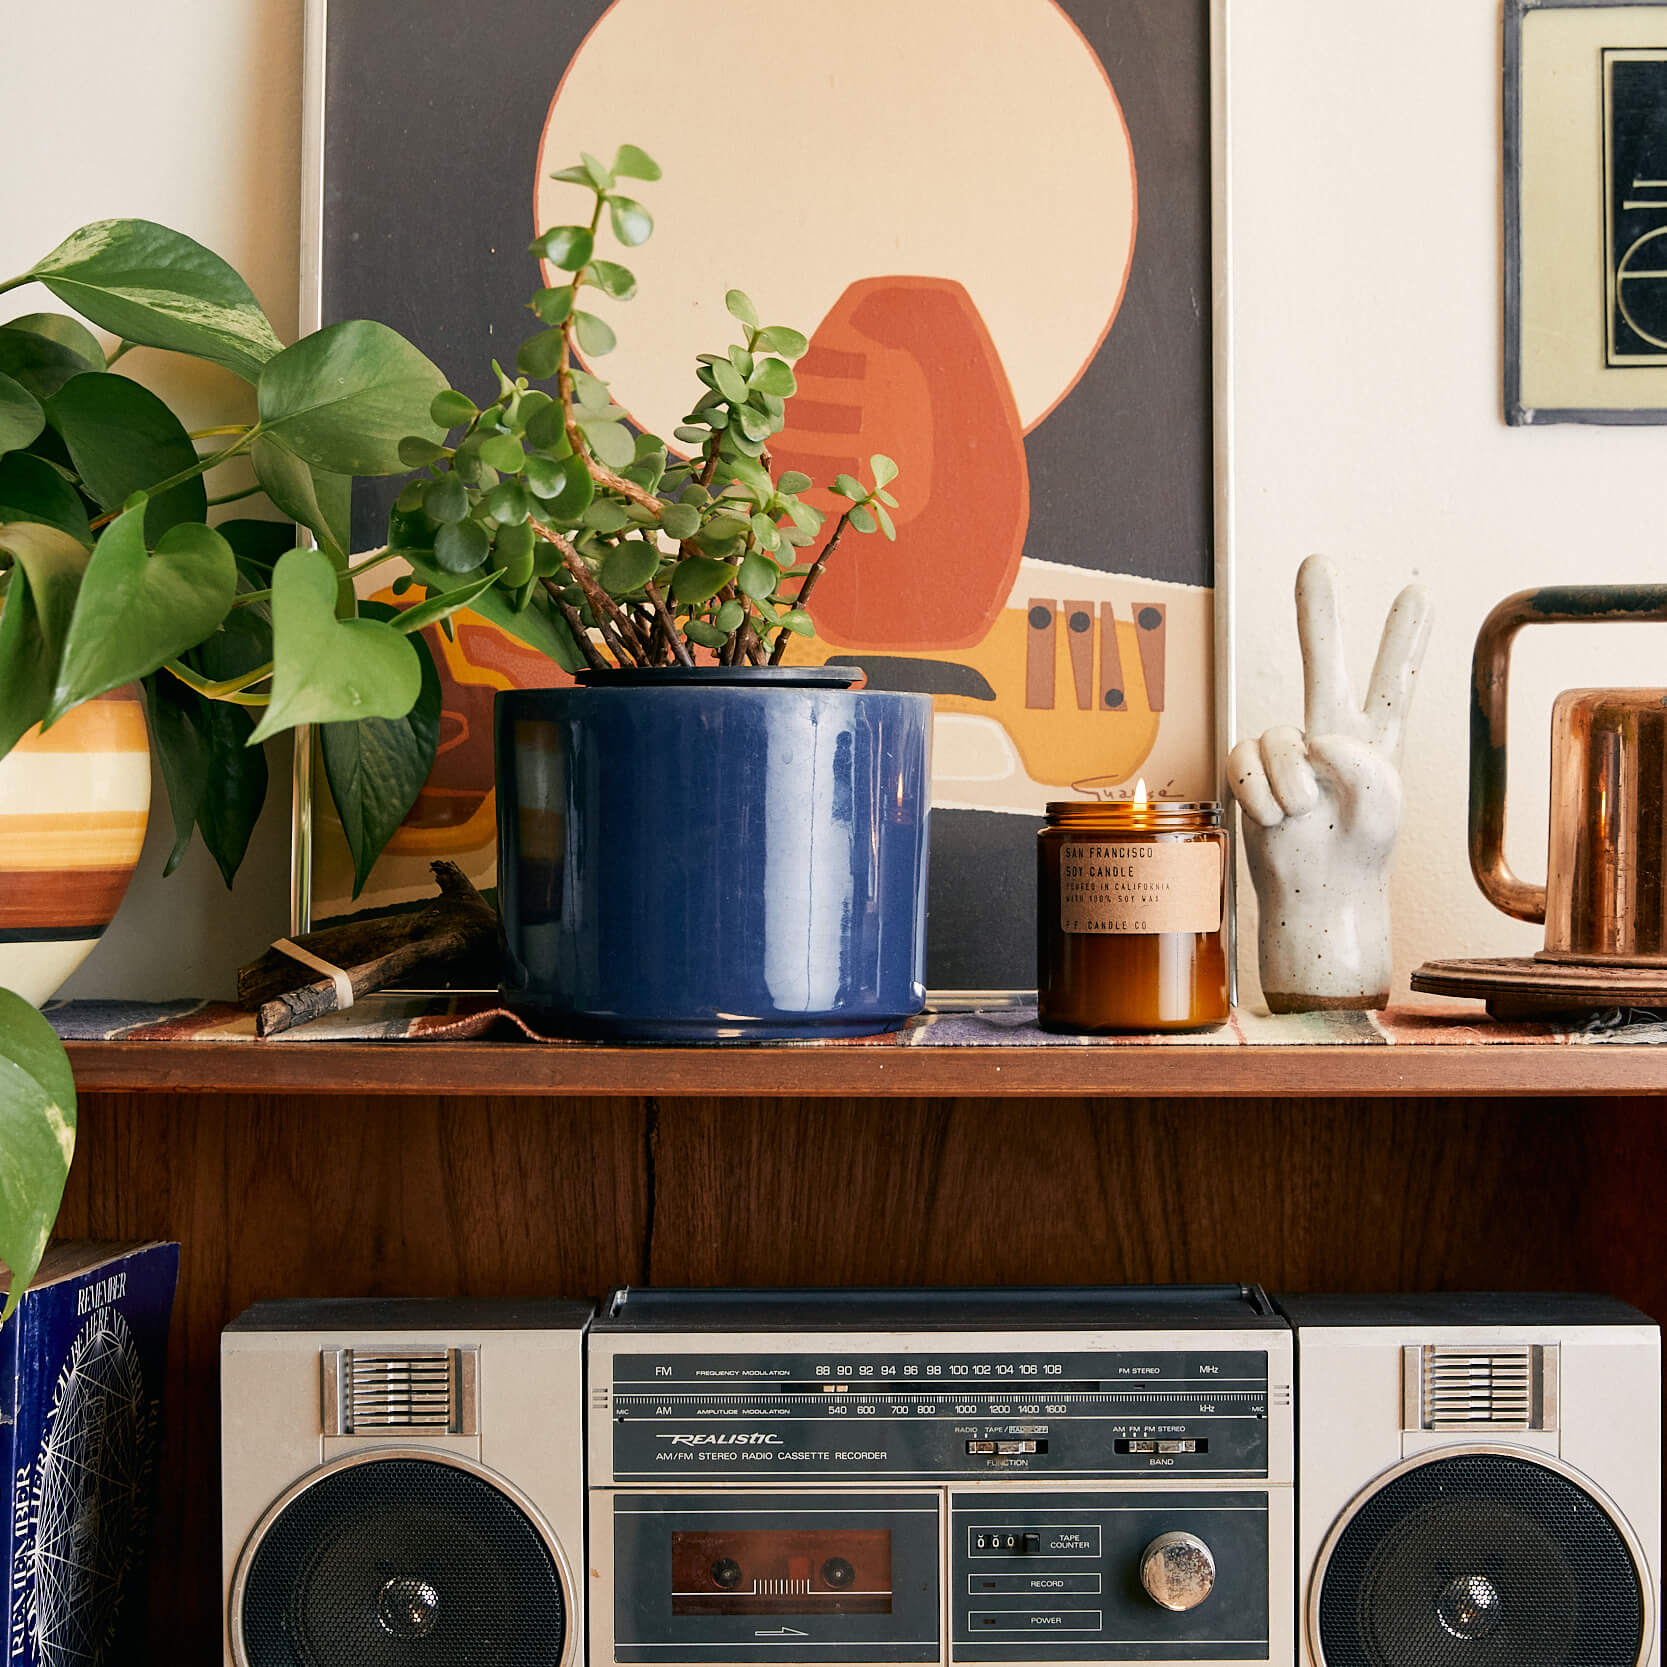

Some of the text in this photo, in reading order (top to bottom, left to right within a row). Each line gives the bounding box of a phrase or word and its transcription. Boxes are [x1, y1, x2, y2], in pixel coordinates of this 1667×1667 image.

[1065, 847, 1153, 859] SAN FRANCISCO
[1066, 866, 1134, 877] SOY CANDLE
[1118, 895, 1135, 903] SOY
[1087, 920, 1128, 930] CANDLE
[77, 1271, 127, 1316] REMEMBER
[655, 1366, 672, 1376] FM
[815, 1365, 831, 1376] 88
[837, 1365, 853, 1376] 90
[858, 1365, 874, 1376] 92
[880, 1365, 897, 1376] 94
[903, 1365, 919, 1376] 96
[926, 1365, 942, 1376] 98
[949, 1365, 969, 1375] 100
[972, 1365, 992, 1375] 102
[995, 1365, 1014, 1375] 104
[1019, 1364, 1038, 1375] 106
[1043, 1364, 1062, 1375] 108
[1199, 1365, 1219, 1374] MHz
[655, 1406, 672, 1415] AM
[828, 1405, 847, 1415] 540
[857, 1405, 875, 1415] 600
[891, 1405, 908, 1415] 700
[917, 1405, 935, 1415] 800
[955, 1405, 977, 1414] 1000
[989, 1405, 1010, 1414] 1200
[1018, 1405, 1039, 1414] 1400
[1045, 1404, 1067, 1414] 1600
[1199, 1404, 1215, 1413] kHz
[656, 1452, 887, 1461] AM/FM STEREO RADIO CASSETTE RECORDER
[12, 1462, 31, 1657] REMEMBER
